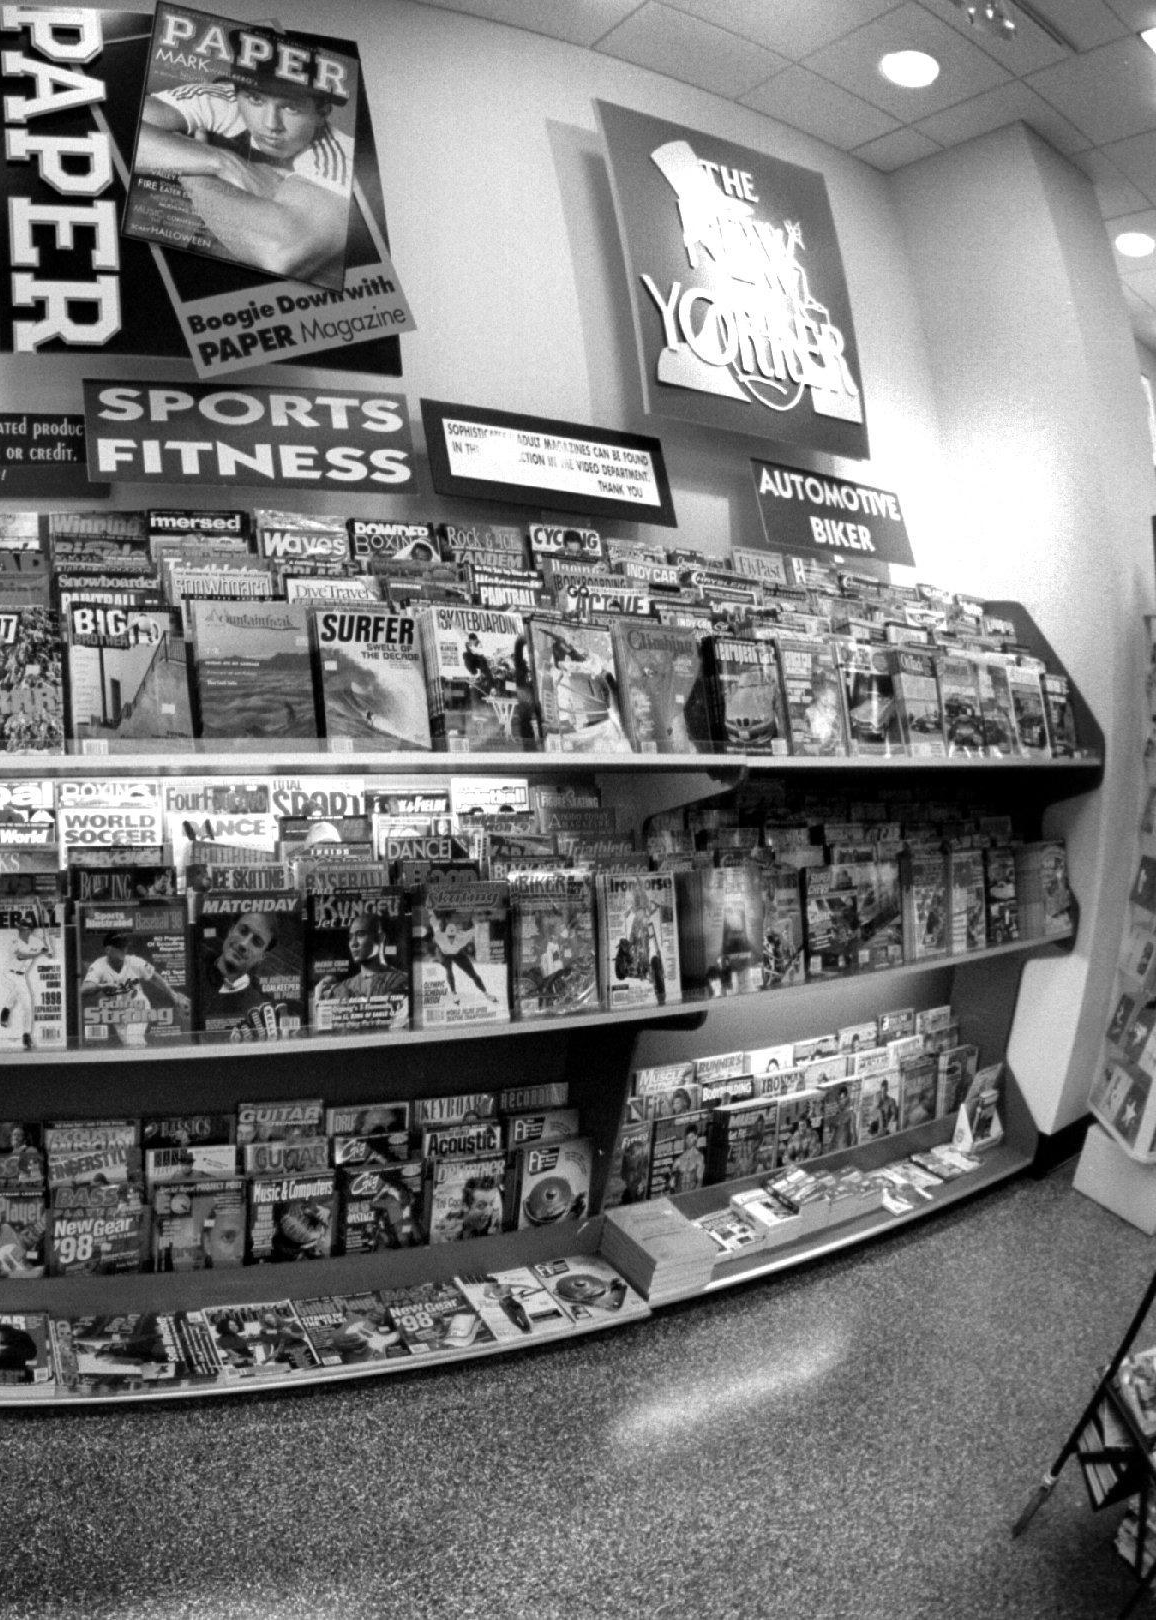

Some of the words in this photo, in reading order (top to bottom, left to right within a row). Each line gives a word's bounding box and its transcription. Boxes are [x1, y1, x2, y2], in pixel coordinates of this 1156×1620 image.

[155, 49, 211, 72] MARK
[161, 14, 350, 98] PAPER
[0, 4, 122, 353] PAPER
[701, 161, 759, 203] THE
[187, 300, 275, 335] Boogie
[276, 290, 344, 314] Down
[345, 275, 395, 300] with
[198, 324, 297, 366] PAPER
[300, 306, 406, 343] Magazine
[642, 275, 860, 398] YORKER
[97, 387, 404, 433] SPORTS
[97, 437, 412, 484] FITNESS
[452, 441, 463, 454] IN
[576, 460, 600, 475] VIDEO
[594, 445, 610, 459] CAN
[612, 448, 621, 461] BE
[623, 450, 649, 466] FOUND
[598, 480, 624, 495] THANK
[626, 486, 644, 499] YOU
[760, 468, 904, 523] AUTOMOTIVE
[264, 532, 345, 557] Waves
[809, 516, 876, 553] BIKER
[452, 551, 522, 568] TANDEM
[58, 574, 161, 590] Snowboarder
[627, 563, 651, 579] INDY
[653, 566, 678, 582] CAR
[295, 585, 326, 598] Dive
[73, 609, 128, 636] BIG
[320, 613, 414, 645] SURFER
[366, 644, 399, 652] SWELL
[400, 645, 413, 653] OF
[631, 629, 693, 653] Climbing
[361, 651, 385, 660] THE
[386, 652, 420, 661] DECADE
[64, 814, 156, 829] WORLD
[4, 829, 49, 844] World
[64, 829, 156, 845] SOCCER
[387, 840, 451, 860] DANCE
[232, 870, 285, 889] SKATING
[94, 911, 125, 920] Sports
[203, 898, 298, 913] MATCHDAY
[85, 918, 134, 928] Illustrated
[315, 919, 335, 929] Jet
[41, 991, 62, 1005] 1998
[262, 983, 301, 993] GOALKEEPER
[698, 1053, 743, 1074] RUNNER'S
[240, 1107, 320, 1123] GUITAR
[48, 1128, 135, 1144] ACOUSTIC
[428, 1130, 497, 1156] Acoustic
[340, 1139, 368, 1160] Gig
[253, 1182, 280, 1203] Music
[281, 1182, 288, 1200] &
[289, 1179, 333, 1202] Computers
[350, 1171, 381, 1195] Gig
[54, 1187, 120, 1208] BASS
[54, 1219, 93, 1238] New
[93, 1216, 134, 1237] Gear
[347, 1213, 375, 1223] ONSTAGE
[54, 1235, 93, 1263] '98
[390, 1305, 423, 1318] New
[425, 1300, 458, 1314] Gear
[396, 1312, 434, 1332] '98
